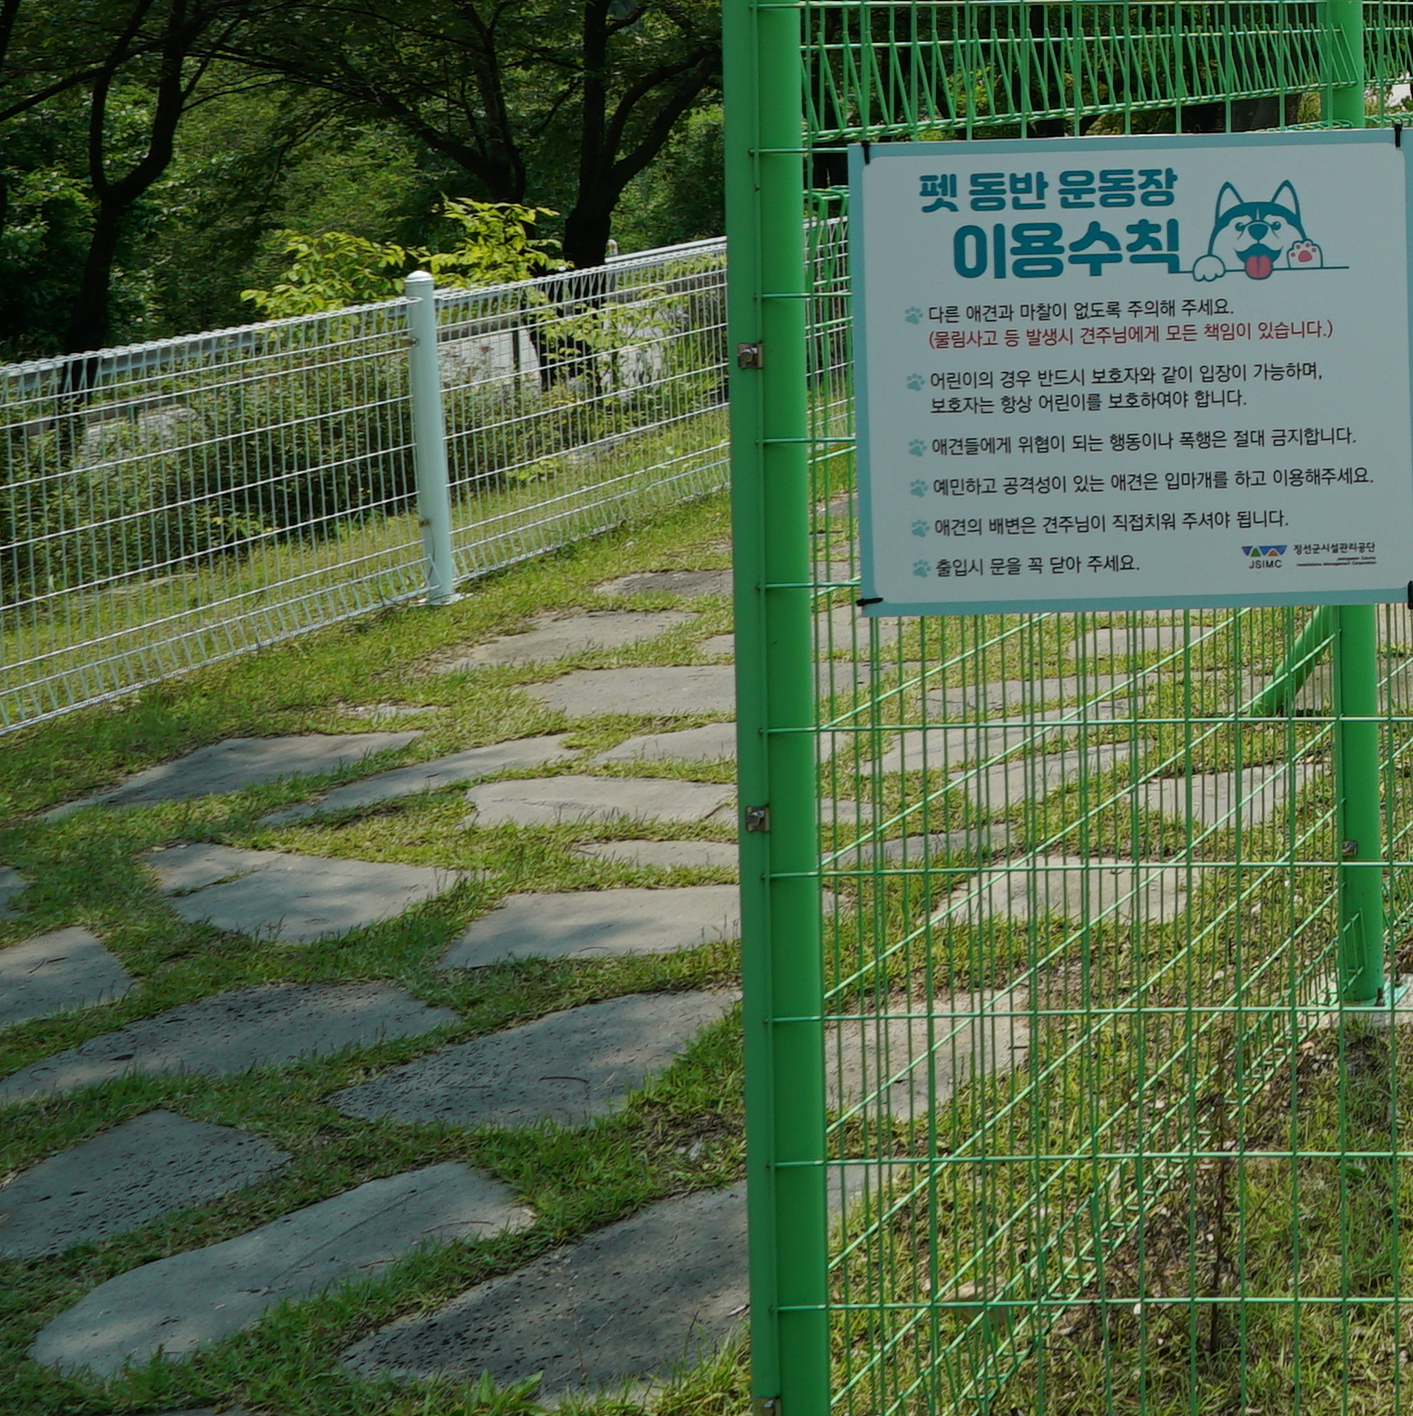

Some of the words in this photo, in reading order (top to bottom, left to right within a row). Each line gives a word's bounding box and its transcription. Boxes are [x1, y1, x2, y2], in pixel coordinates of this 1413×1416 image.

[919, 174, 960, 214] 펫
[969, 171, 1049, 211] 동반
[1058, 168, 1178, 209] 운동장
[953, 218, 1181, 279] 이용수칙
[928, 306, 961, 324] 다른
[965, 304, 1015, 323] 애견과
[1019, 303, 1067, 322] 마찰이
[1073, 302, 1122, 321] 없도록
[1126, 300, 1176, 319] 주의해
[1181, 299, 1234, 317] 주세요.
[928, 330, 999, 350] (물림사고
[1003, 330, 1021, 348] 등
[1026, 328, 1074, 347] 발생시
[1079, 325, 1160, 345] 견주님에게
[1165, 325, 1199, 342] 모든
[1203, 323, 1251, 342] 책임이
[1257, 320, 1334, 340] 있습니다.)
[930, 371, 994, 391] 어린이의
[1000, 371, 1032, 389] 경우
[1037, 369, 1085, 388] 반드시
[1090, 367, 1156, 385] 보호자와
[1161, 366, 1193, 385] 같이
[1199, 364, 1247, 383] 입장이
[1253, 362, 1323, 382] 가능하며,
[930, 397, 995, 415] 보호자는
[1000, 395, 1033, 414] 항상
[1038, 394, 1103, 413] 어린이를
[1107, 391, 1189, 410] 보호하여야
[1194, 389, 1247, 409] 합니다.
[931, 437, 1012, 456] 애견들에게
[1017, 436, 1065, 454] 위협이
[1071, 435, 1104, 453] 되는
[1109, 432, 1174, 452] 행동이나
[1178, 431, 1228, 450] 폭행은
[1233, 430, 1265, 448] 절대
[1270, 427, 1357, 447] 금지합니다.
[933, 478, 998, 497] 예민하고
[1002, 476, 1067, 496] 공격성이
[1072, 475, 1106, 493] 있는
[1110, 473, 1159, 492] 애견은
[1164, 471, 1229, 491] 입마개를
[1234, 471, 1267, 489] 하고
[1272, 467, 1374, 488] 이용해주세요.
[934, 518, 983, 537] 애견의
[988, 517, 1037, 535] 배변은
[1042, 515, 1106, 534] 견주님이
[1111, 513, 1176, 532] 직접치워
[1181, 511, 1231, 531] 주셔야
[1236, 510, 1289, 529] 됩니다.
[1293, 542, 1376, 555] 정선군시설관리공단
[935, 559, 984, 578] 출입시
[989, 558, 1022, 576] 문을
[1027, 557, 1044, 575] 꼭
[1049, 556, 1083, 575] 닫아
[1086, 555, 1140, 574] 주세요.
[1248, 560, 1283, 570] JSIMC
